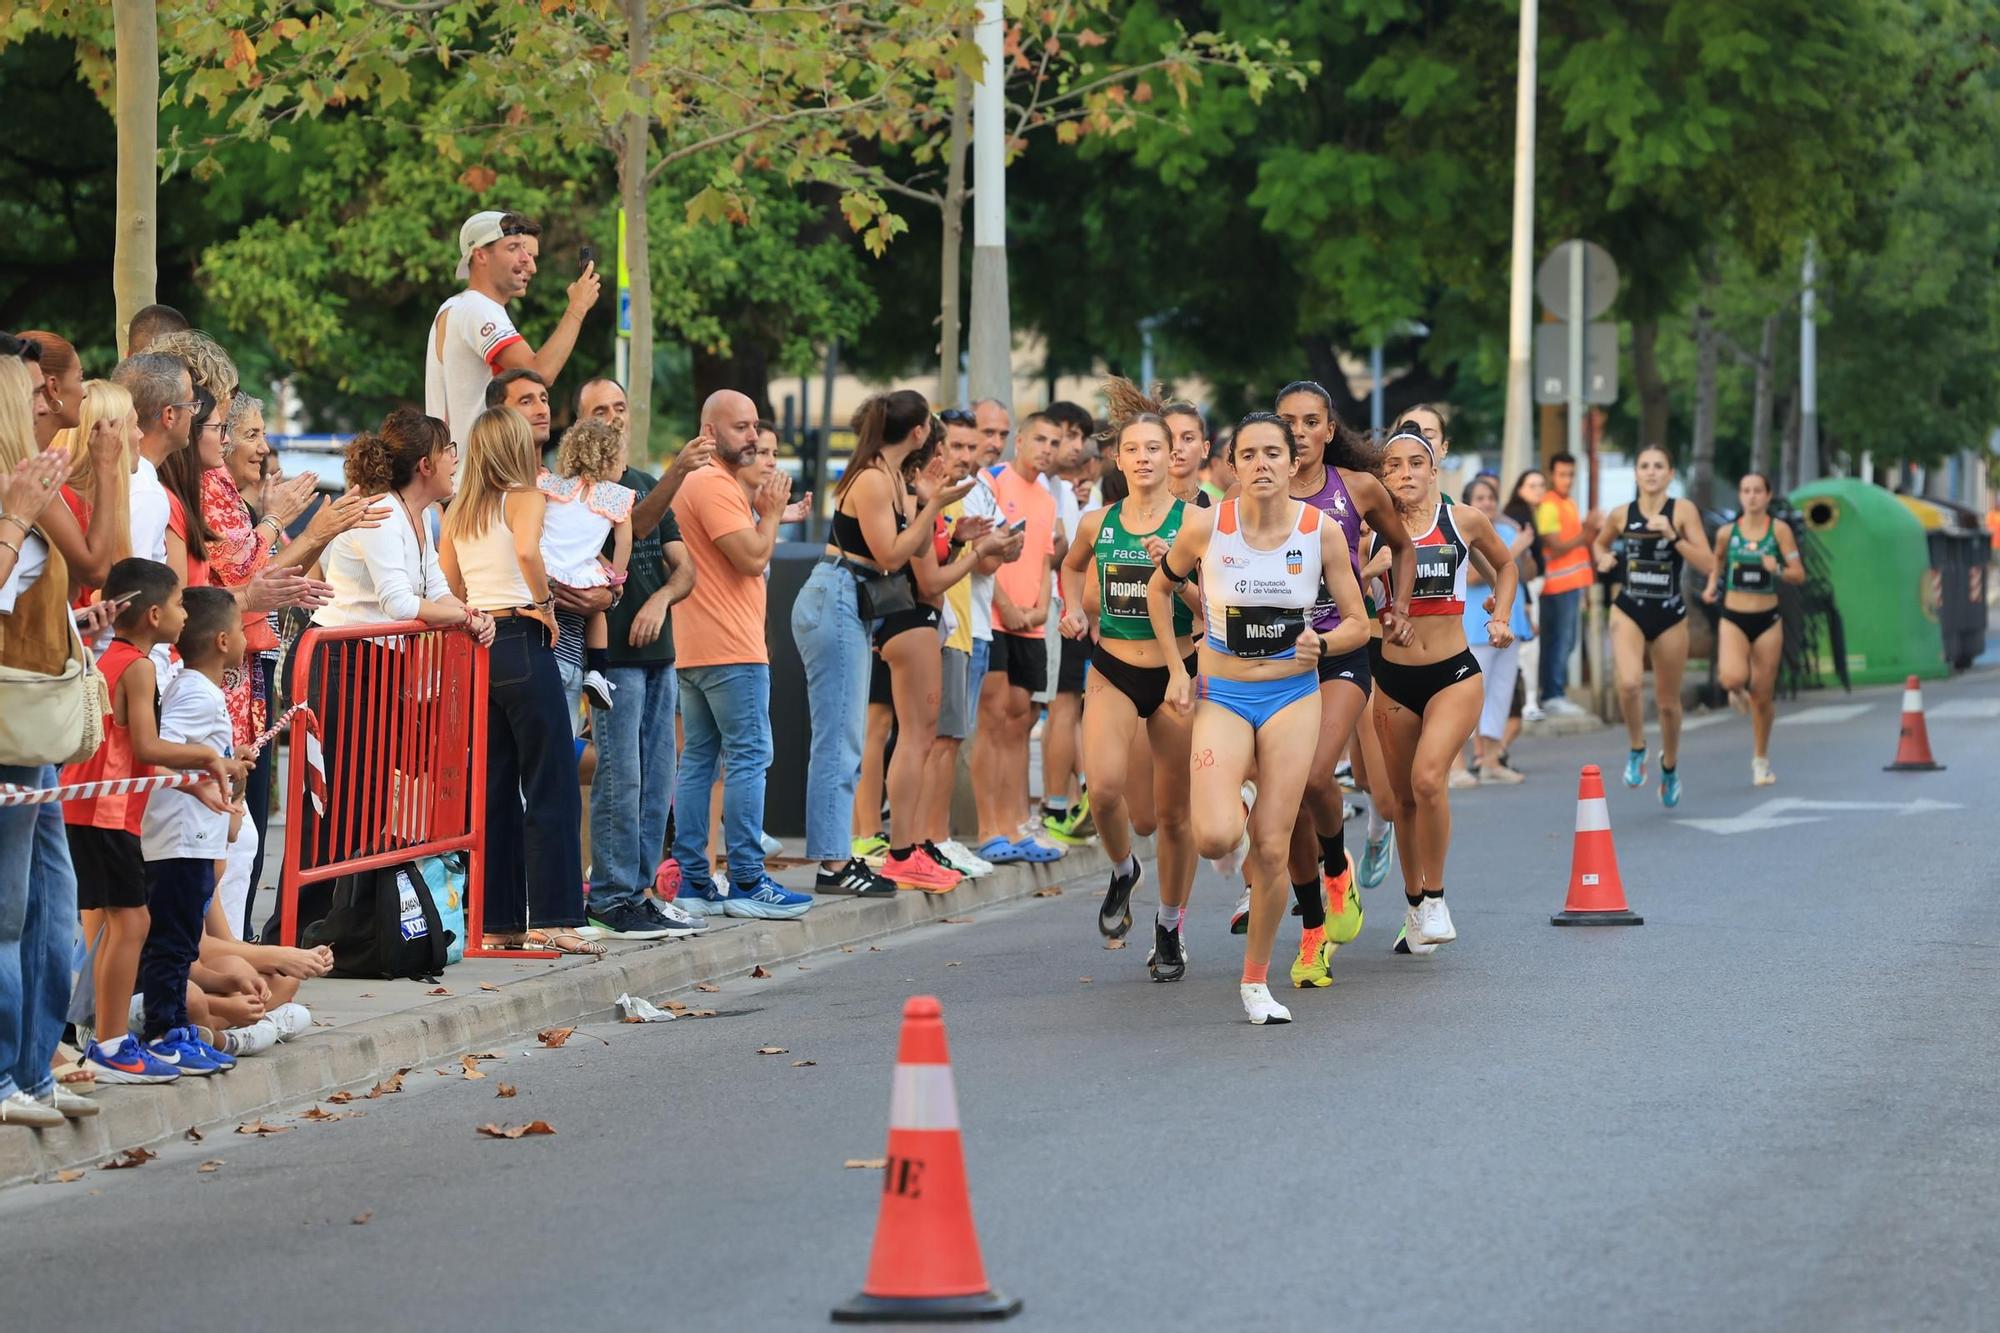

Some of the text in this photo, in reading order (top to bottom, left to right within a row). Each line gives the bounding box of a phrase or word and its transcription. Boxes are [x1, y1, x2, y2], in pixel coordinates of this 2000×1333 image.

[1415, 562, 1451, 579] VAJAL
[1253, 580, 1287, 588] Diputació
[1246, 623, 1286, 639] MASIP
